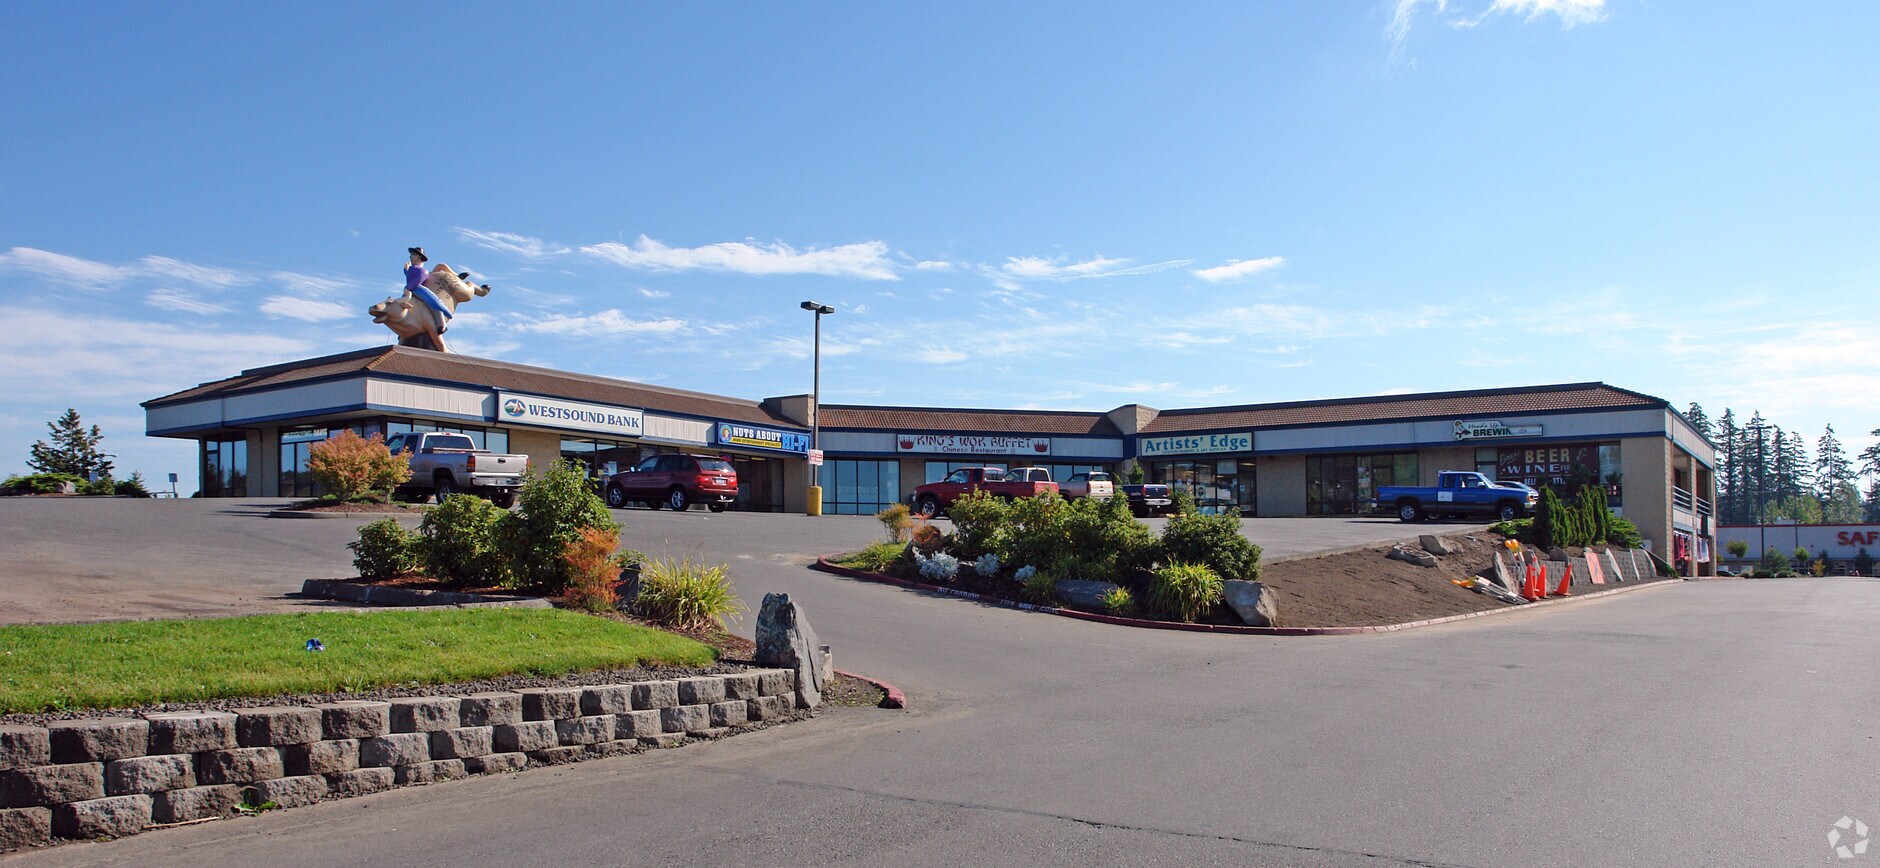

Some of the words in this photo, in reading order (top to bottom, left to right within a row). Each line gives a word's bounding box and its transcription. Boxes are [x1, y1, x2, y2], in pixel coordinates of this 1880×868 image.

[529, 404, 605, 424] WESTSOUND
[607, 414, 640, 428] BANK
[733, 427, 754, 438] NUTS
[756, 430, 781, 441] ABOUT
[781, 433, 809, 452] HI-FI
[916, 435, 954, 446] KING'S
[960, 436, 987, 447] WOK
[991, 437, 1032, 448] BUFFET
[1145, 437, 1203, 452] Artists'
[1210, 435, 1248, 450] Edge
[1525, 448, 1570, 464] BEER
[1837, 531, 1880, 545] SAF
